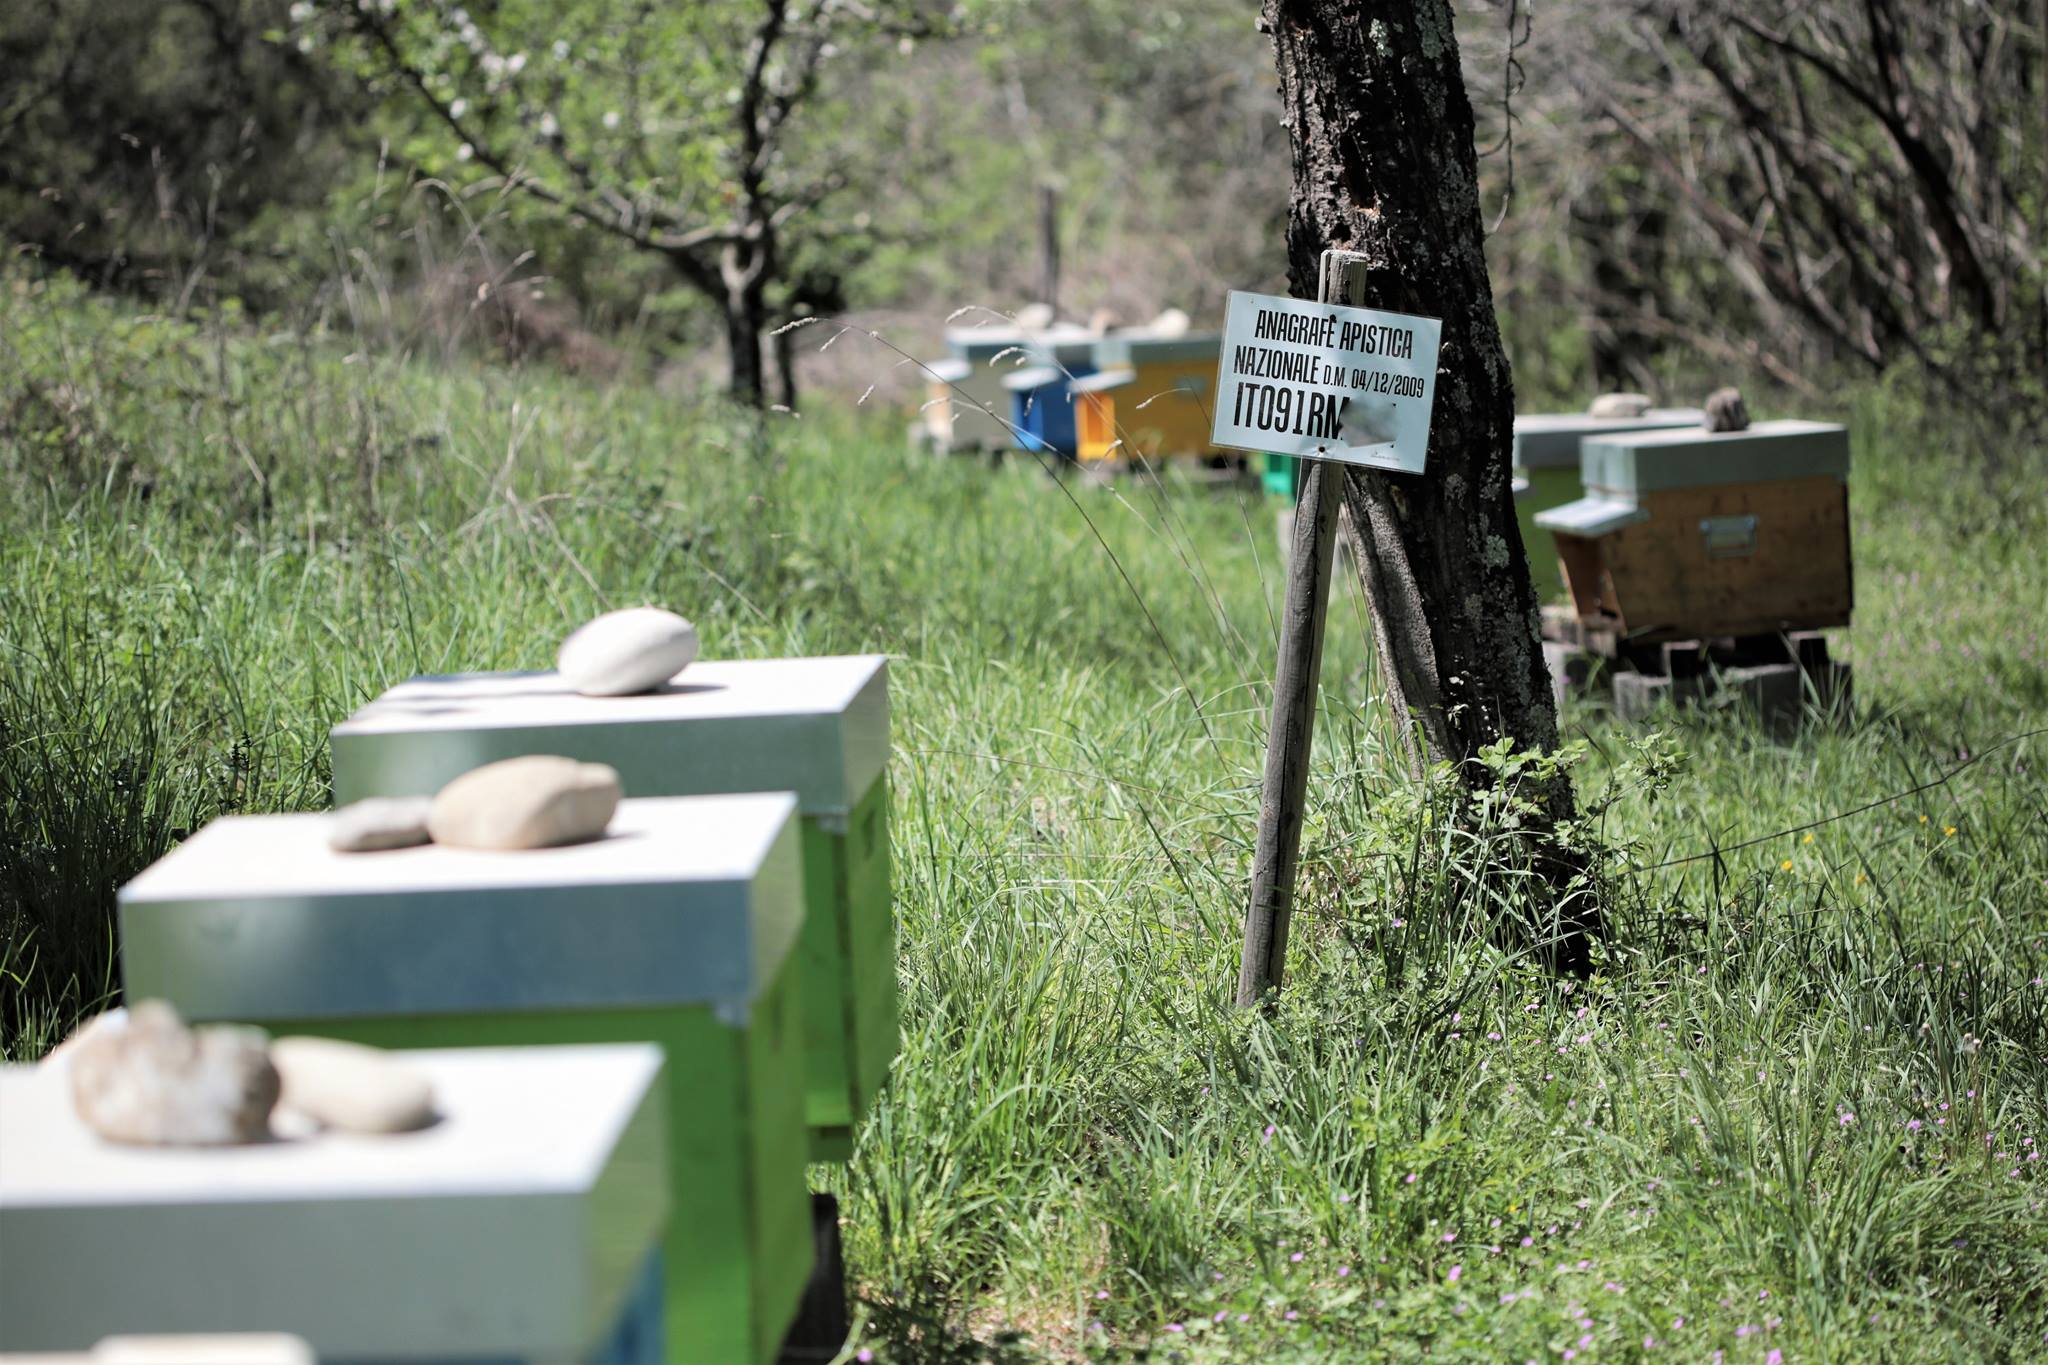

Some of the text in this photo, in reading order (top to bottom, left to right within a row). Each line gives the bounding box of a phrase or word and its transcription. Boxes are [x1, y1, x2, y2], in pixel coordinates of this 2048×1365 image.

[1254, 309, 1413, 360] ANAGRAFE APISTICA
[1233, 344, 1425, 399] NAZIONALE D.M. 04/12/2009
